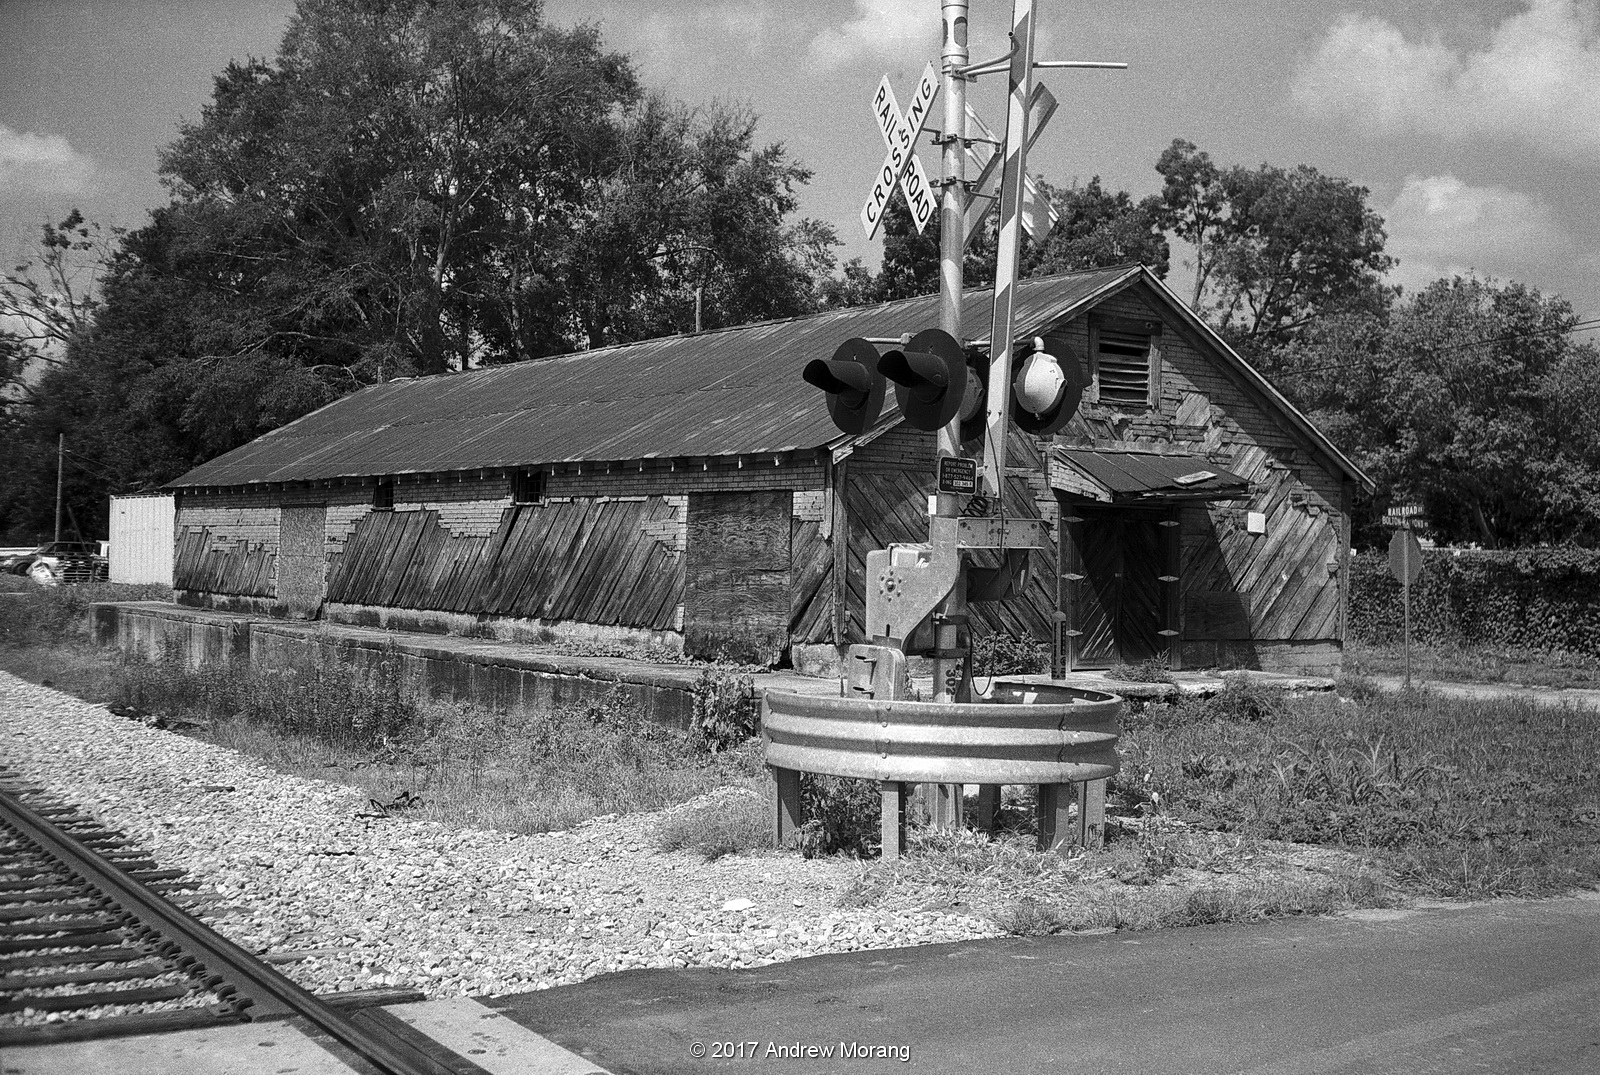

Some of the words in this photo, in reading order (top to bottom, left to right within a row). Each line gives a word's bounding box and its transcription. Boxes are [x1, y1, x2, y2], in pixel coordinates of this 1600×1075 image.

[866, 78, 931, 223] CROSSING
[875, 86, 897, 144] RAIL
[903, 160, 929, 223] ROAD
[1388, 506, 1417, 516] RAILROAD
